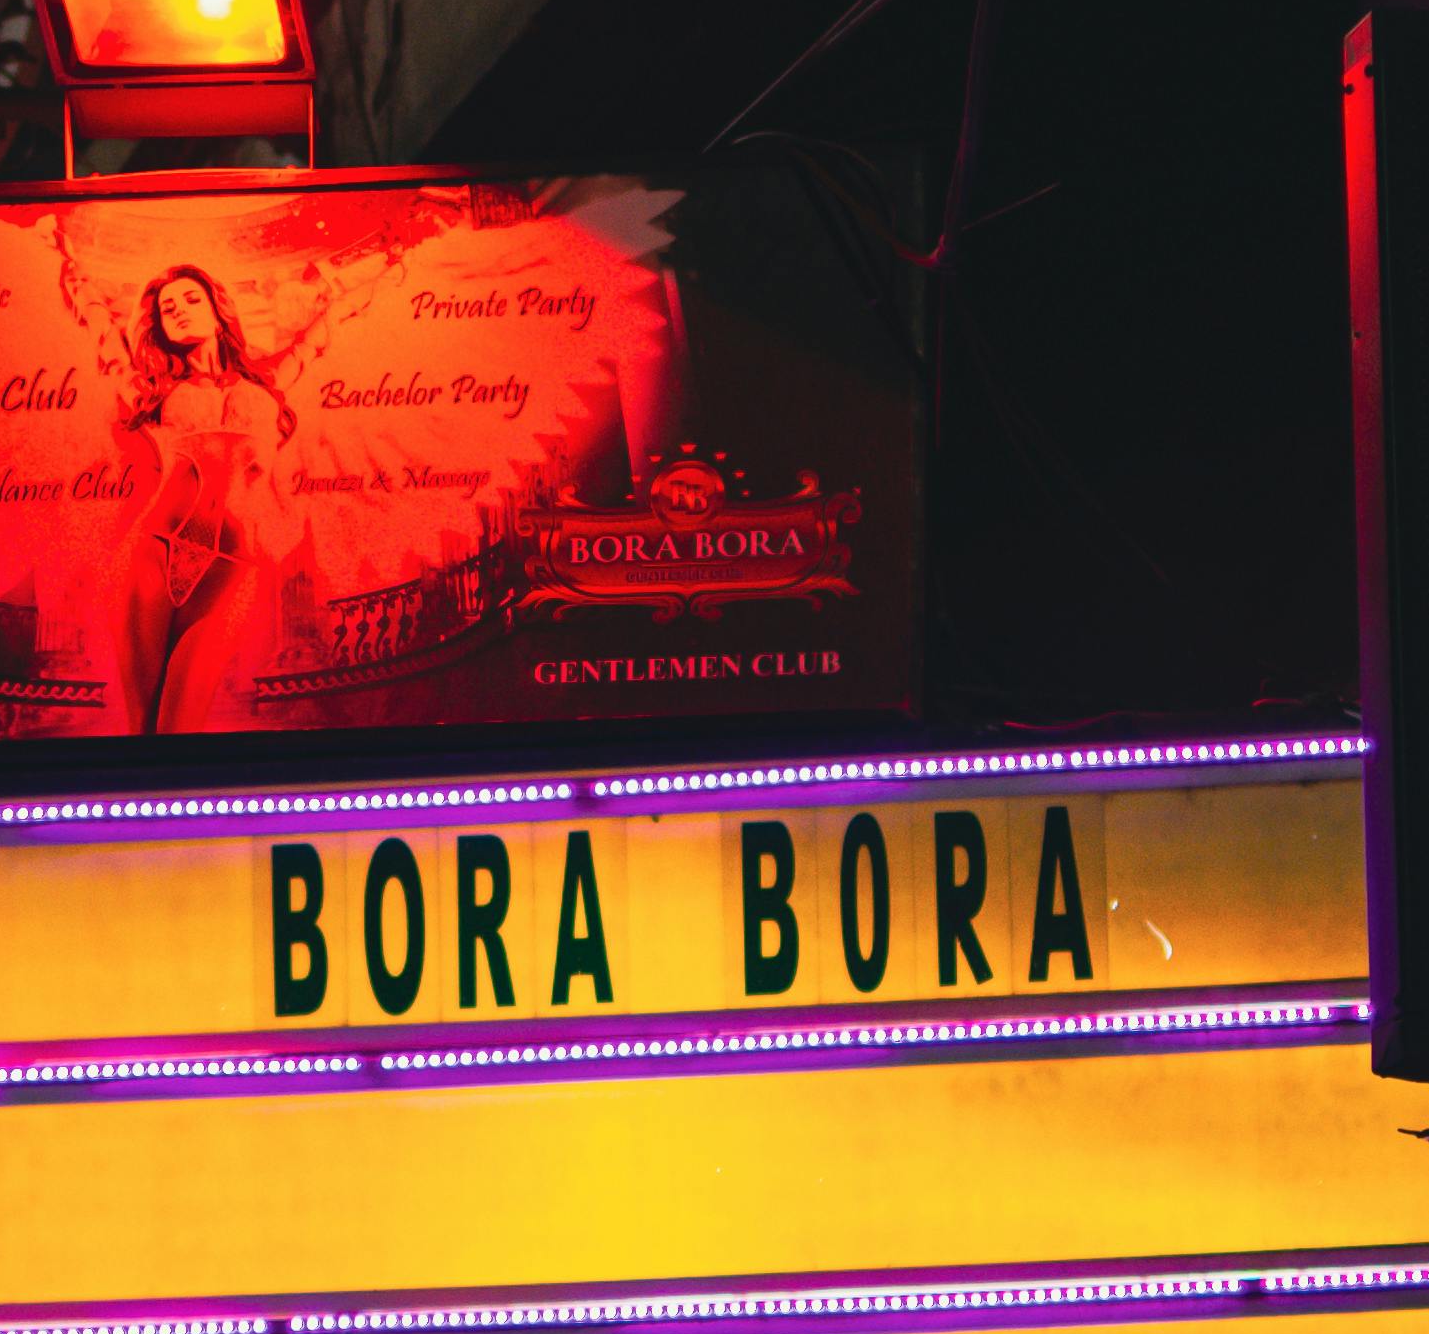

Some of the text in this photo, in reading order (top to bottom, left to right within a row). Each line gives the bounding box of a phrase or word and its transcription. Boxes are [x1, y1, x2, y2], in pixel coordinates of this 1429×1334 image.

[410, 286, 597, 330] Private Party
[0, 366, 78, 413] Club
[319, 371, 531, 418] Bachelor Party
[71, 463, 136, 501] Club
[569, 528, 806, 564] BORA BORA
[533, 649, 843, 684] GENTLEMEN CLUB
[270, 805, 1094, 1018] BORA BORA
